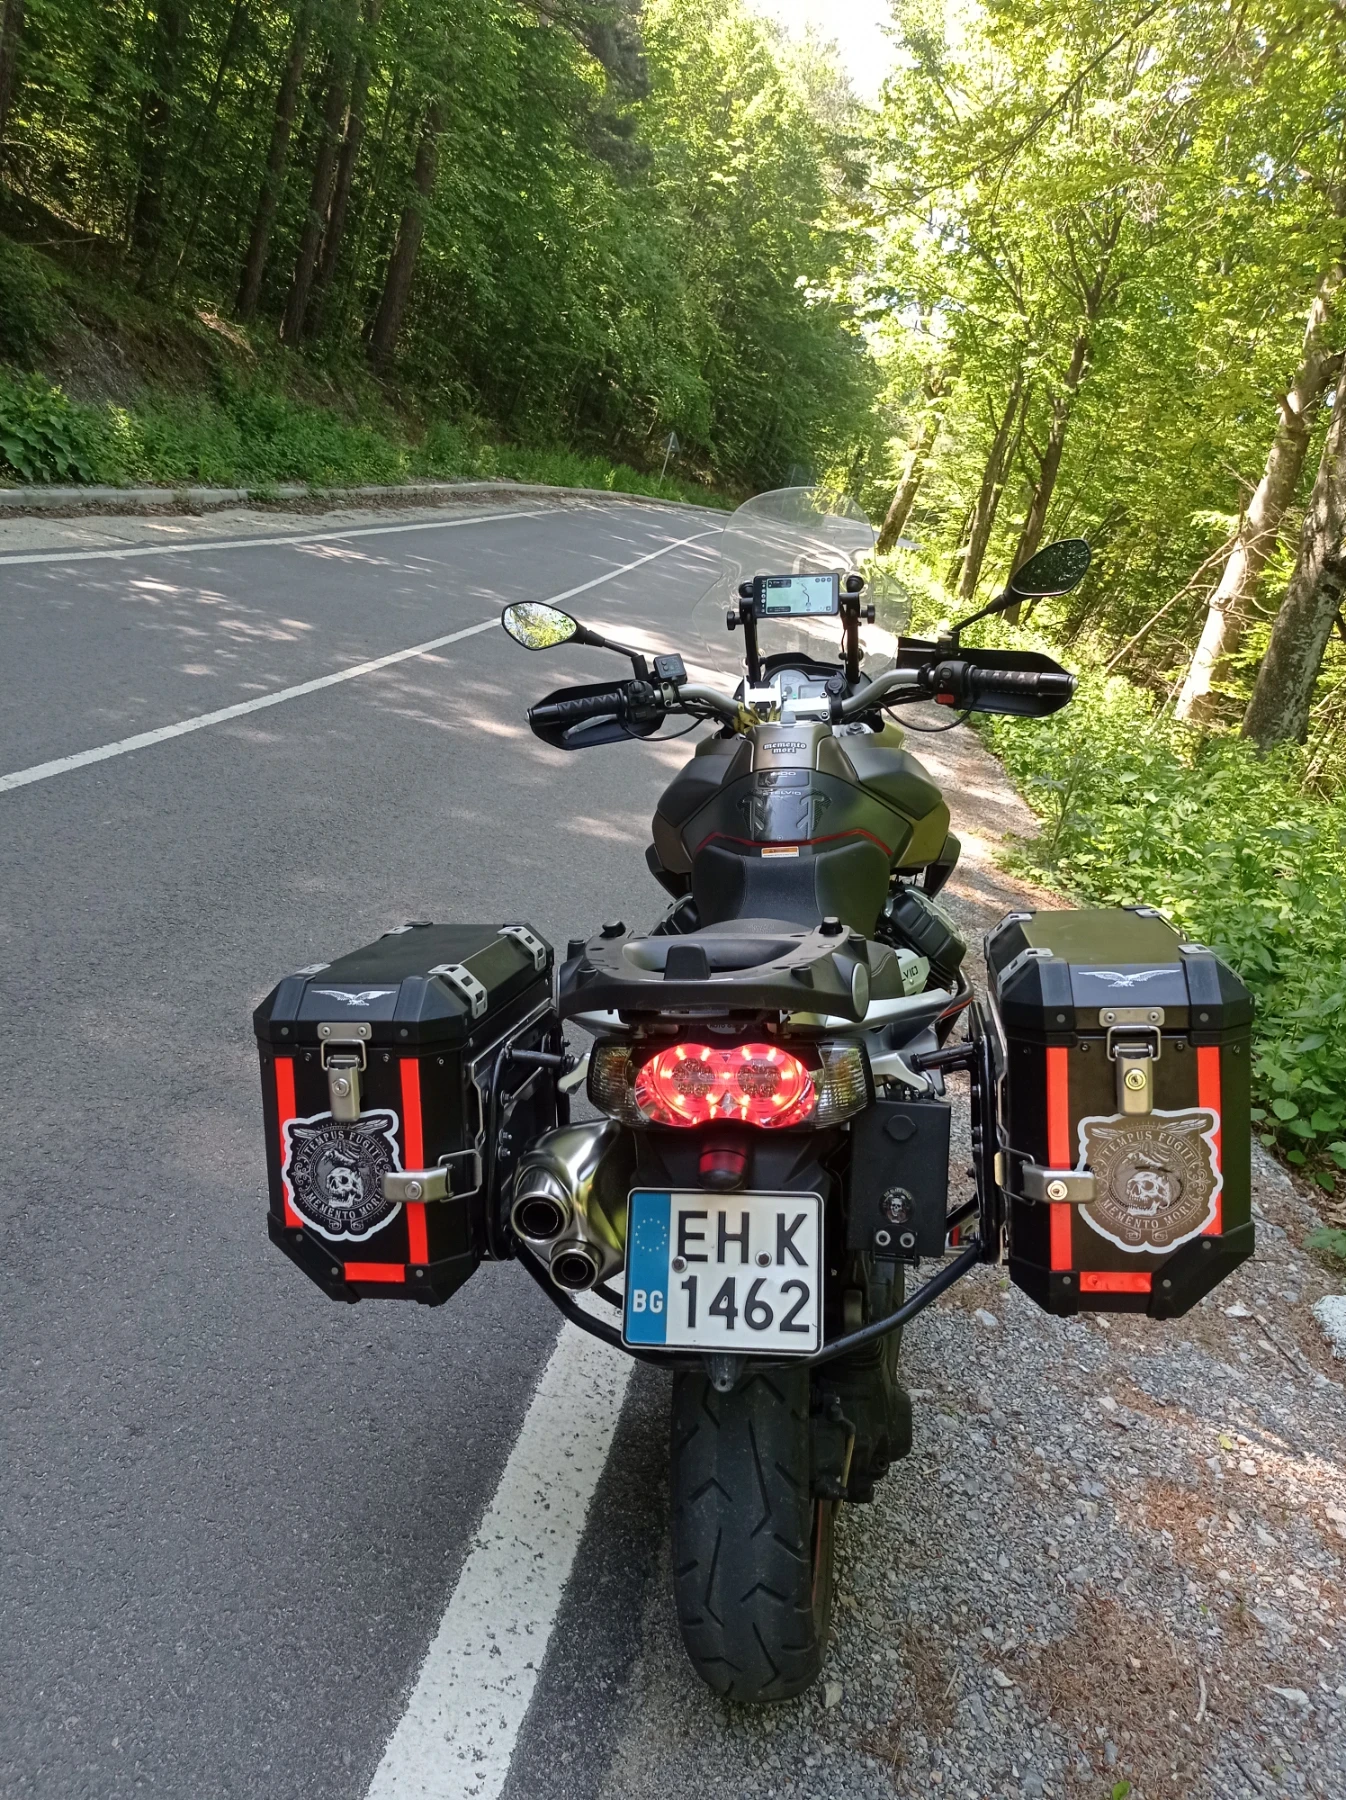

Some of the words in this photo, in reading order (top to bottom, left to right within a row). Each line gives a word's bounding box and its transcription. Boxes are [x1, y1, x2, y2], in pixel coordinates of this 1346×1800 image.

[763, 742, 806, 750] memento
[304, 1130, 345, 1156] TEMPUS
[349, 1132, 381, 1157] FUGIT
[1102, 1130, 1153, 1159] TEMPUS
[1158, 1132, 1196, 1161] FUGIT
[305, 1193, 356, 1220] MEMENTO
[359, 1193, 384, 1216] MORI
[1101, 1198, 1159, 1229] MEMENTO
[1165, 1201, 1194, 1226] MORI
[632, 1289, 664, 1314] BG
[681, 1275, 811, 1333] 1462
